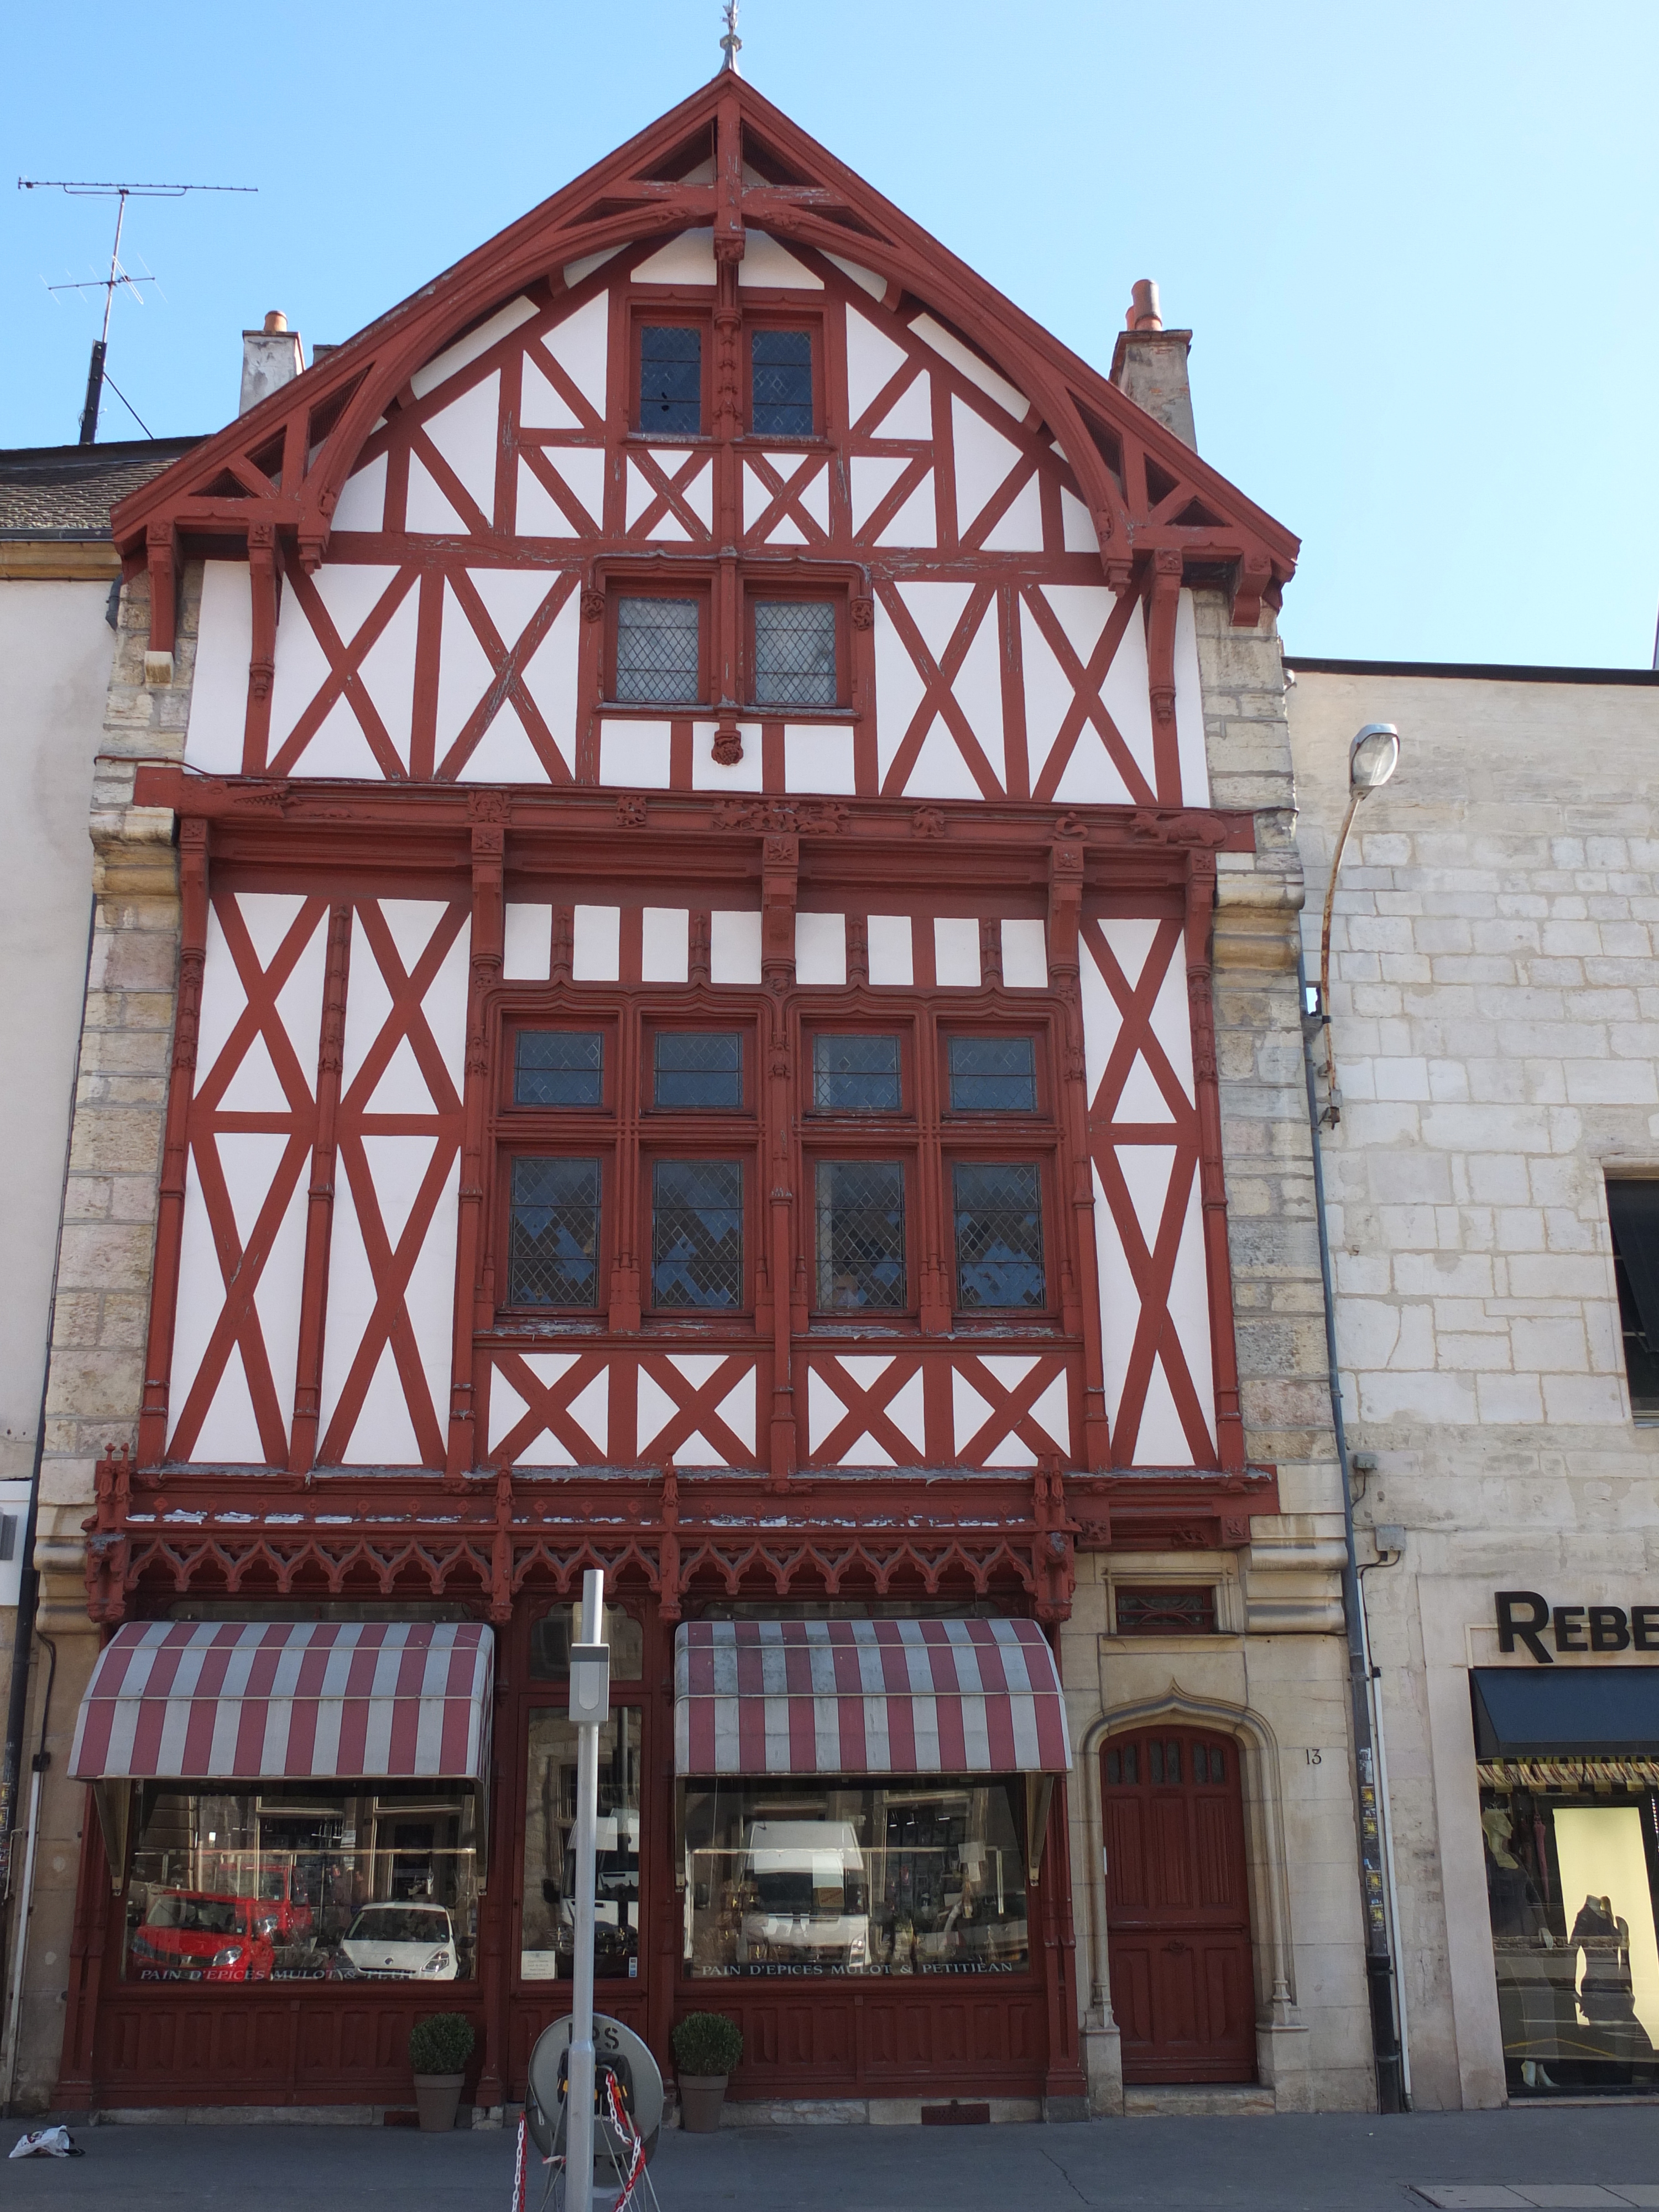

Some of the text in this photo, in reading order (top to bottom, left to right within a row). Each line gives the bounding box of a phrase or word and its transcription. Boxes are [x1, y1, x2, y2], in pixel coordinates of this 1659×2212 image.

[1495, 1591, 1659, 1663] REBE
[1306, 1749, 1322, 1765] 13
[140, 1970, 181, 1980] PAIN
[190, 1970, 265, 1980] D'EPICES
[273, 1969, 337, 1979] MULOT
[343, 1969, 358, 1979] &
[702, 1963, 1013, 1975] PAIN D'EPICES MULOT & PETITJEAN
